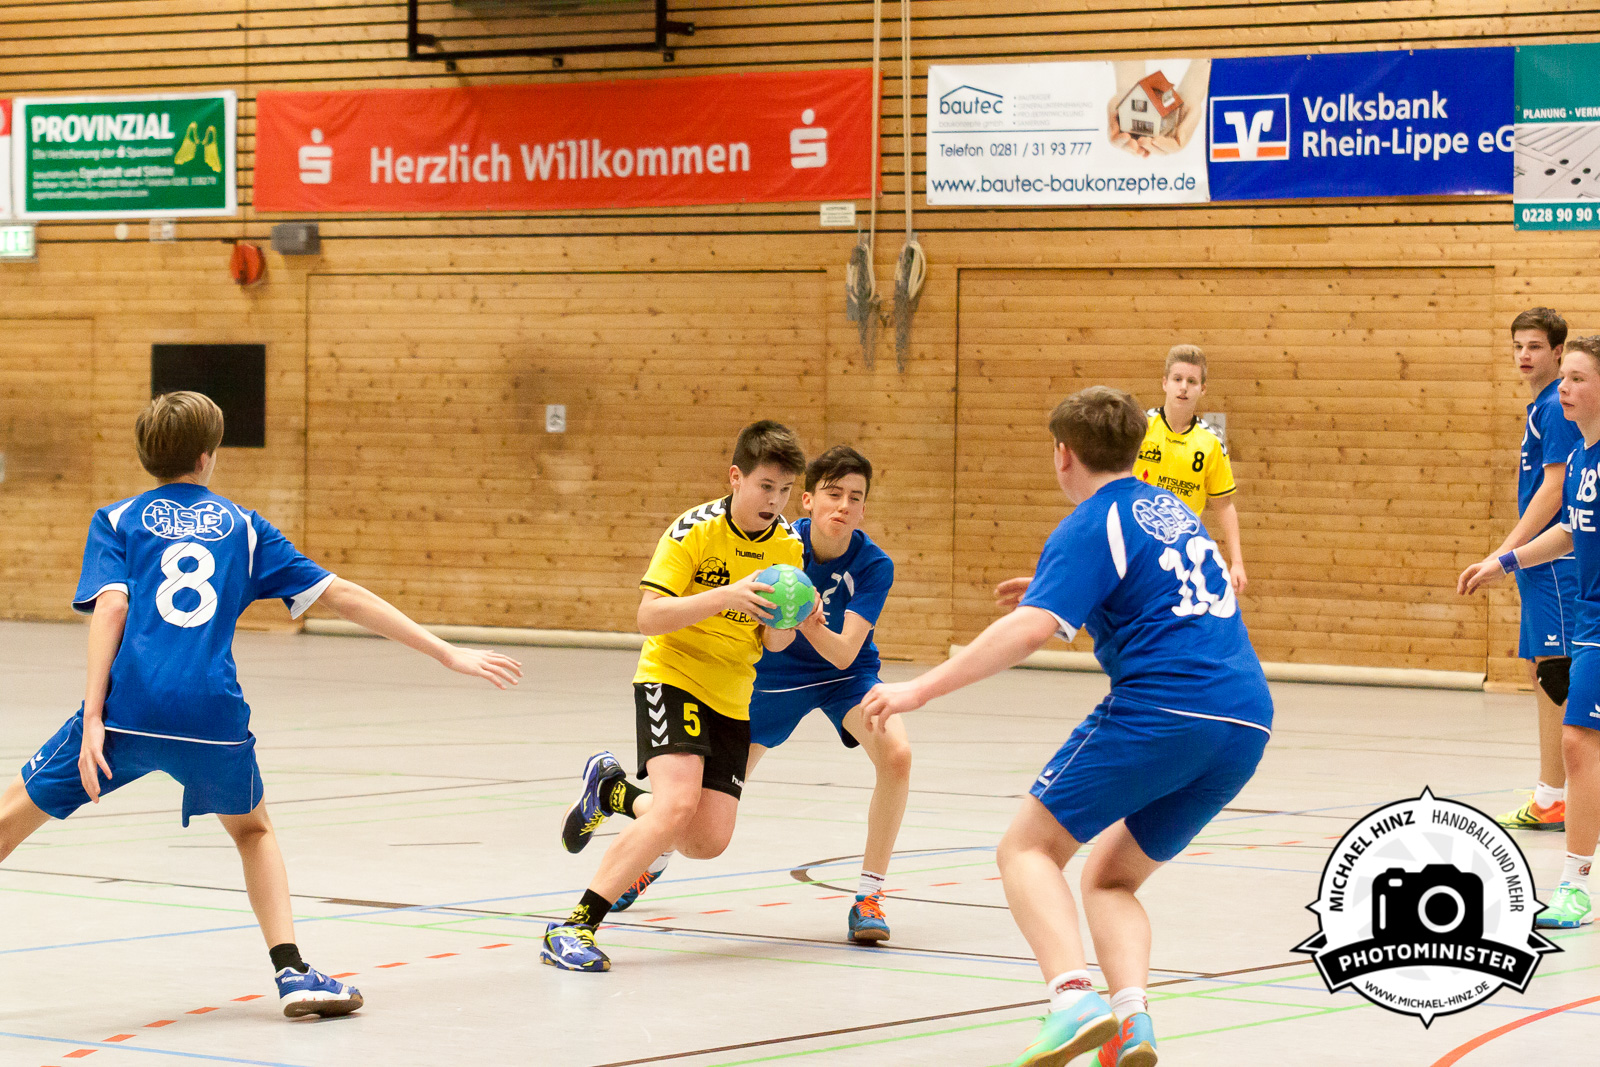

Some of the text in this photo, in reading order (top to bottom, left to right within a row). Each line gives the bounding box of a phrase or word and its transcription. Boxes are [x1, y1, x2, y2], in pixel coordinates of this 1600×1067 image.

[939, 97, 1004, 115] bautec
[1302, 90, 1448, 123] Volksbank
[1523, 108, 1566, 119] PLANUNG
[31, 113, 175, 143] PROVINZIAL
[939, 143, 983, 157] Telefon
[990, 143, 1017, 157] 0281
[1032, 142, 1046, 156] 31
[1050, 142, 1066, 156] 93
[1070, 141, 1093, 156] 777
[1302, 125, 1515, 161] Rhein-Lippe eG
[370, 139, 750, 184] Herzlich Willkommen
[931, 173, 1196, 195] www.bautec-baukonzepte.de
[1522, 208, 1553, 223] 0228
[1556, 207, 1573, 222] 90
[1576, 207, 1593, 222] 90
[1192, 451, 1205, 473] 8
[1157, 475, 1201, 491] MITSUBISHI
[1576, 467, 1598, 503] 18
[735, 548, 765, 560] hummel
[156, 542, 217, 629] 8
[695, 572, 730, 585] ART
[1158, 536, 1236, 619] 10
[683, 702, 701, 737] 5
